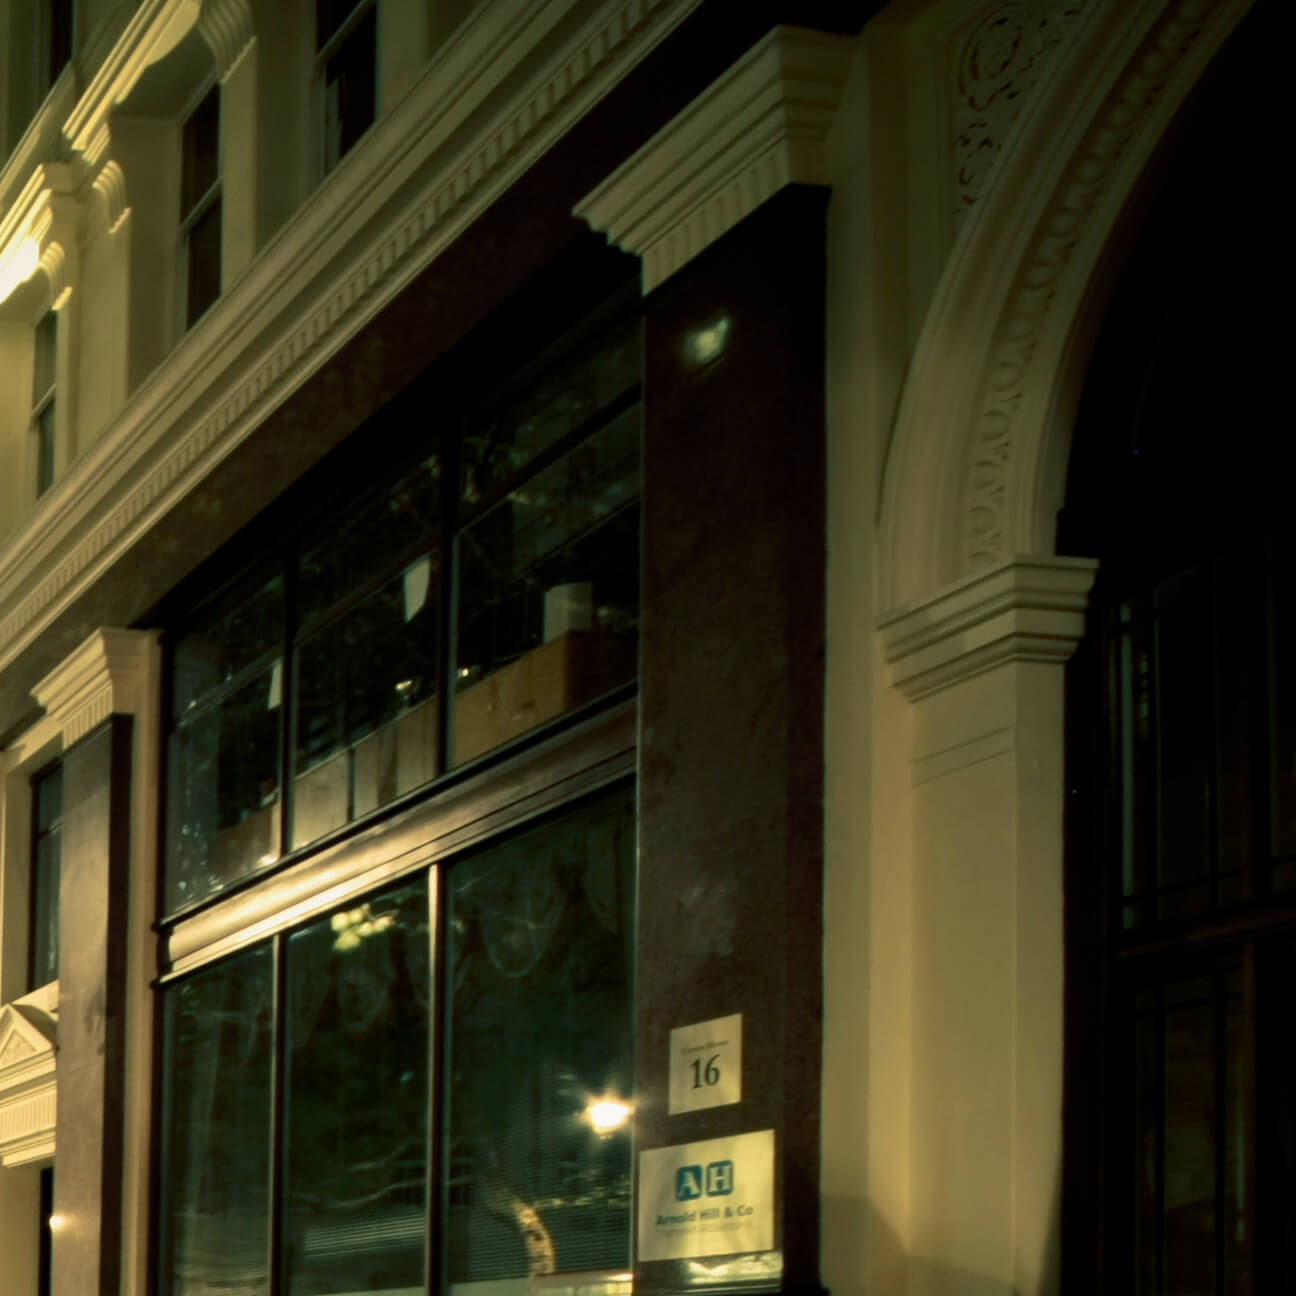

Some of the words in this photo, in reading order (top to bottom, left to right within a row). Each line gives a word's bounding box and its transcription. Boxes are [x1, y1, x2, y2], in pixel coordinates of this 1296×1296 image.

[690, 1053, 720, 1089] 16
[656, 1211, 696, 1225] Arnold
[700, 1207, 720, 1220] Hill
[724, 1206, 732, 1218] &
[737, 1204, 753, 1216] Co
